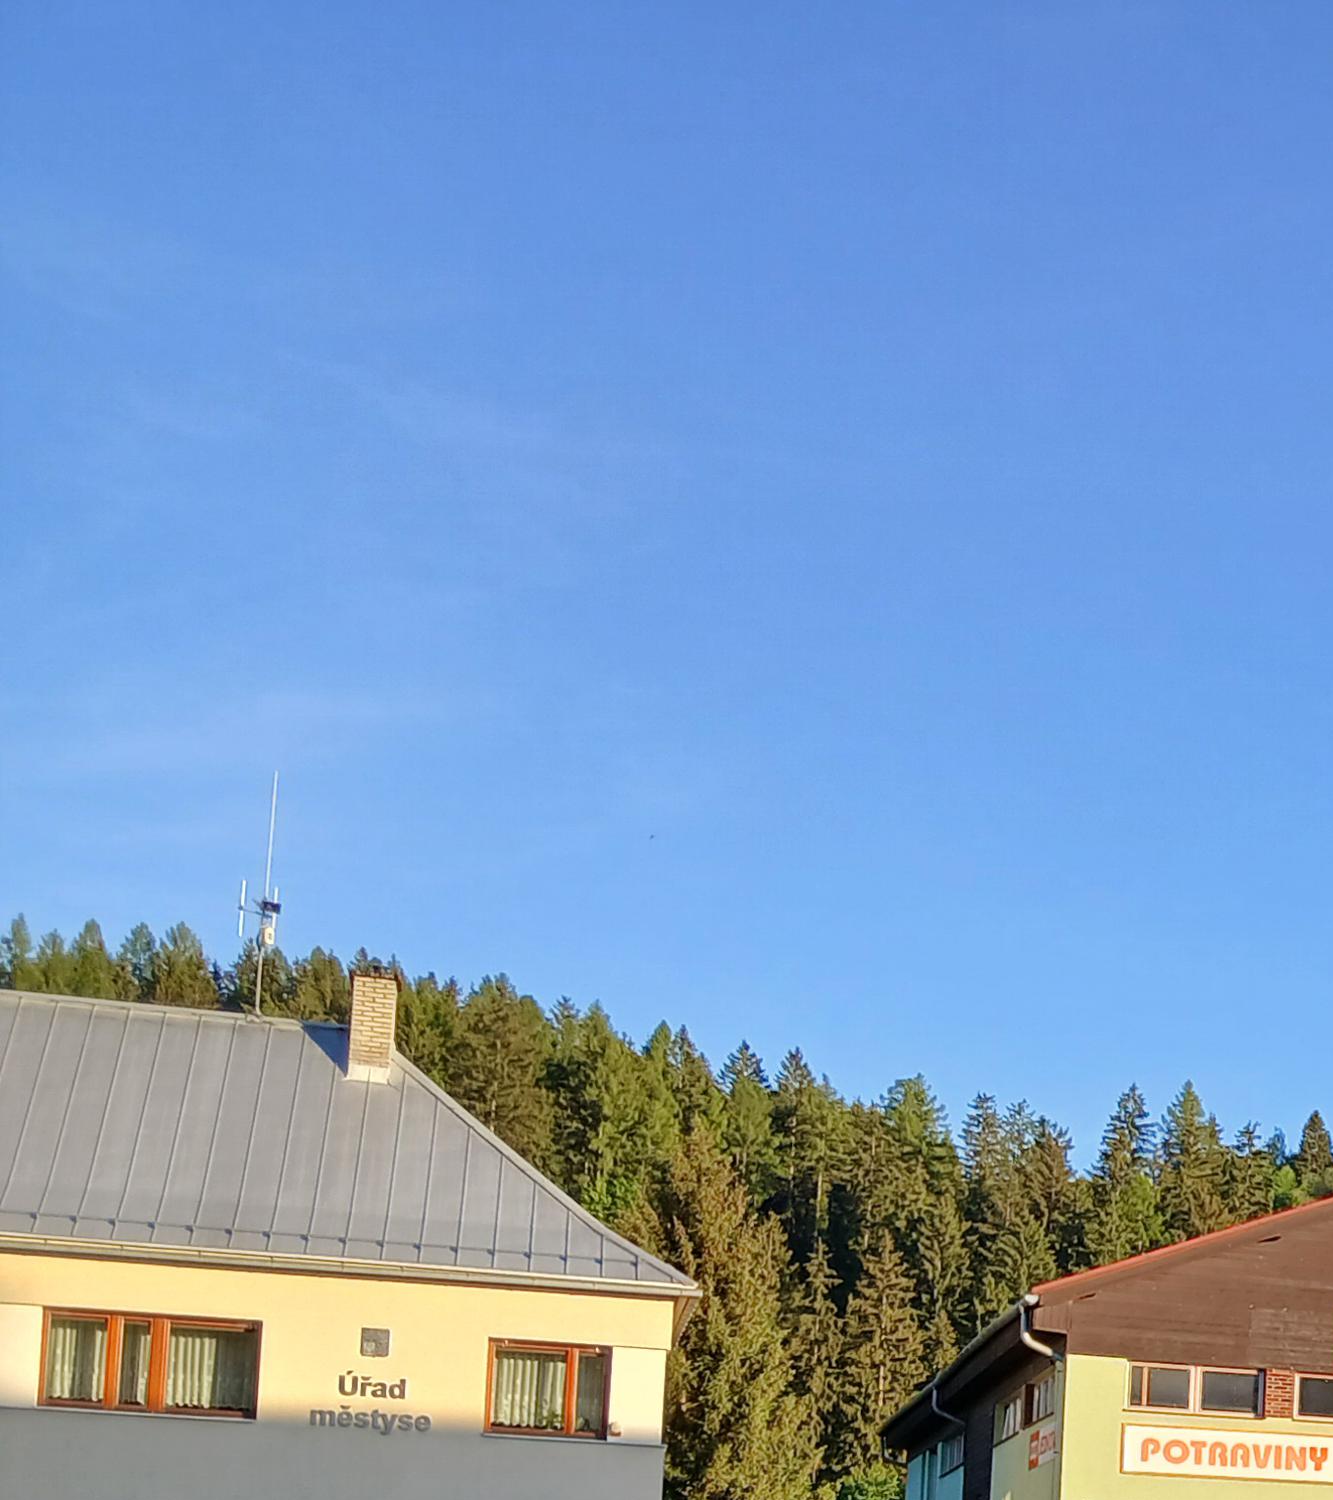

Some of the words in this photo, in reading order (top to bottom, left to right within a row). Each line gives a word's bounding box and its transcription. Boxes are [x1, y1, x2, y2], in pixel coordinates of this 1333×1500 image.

[338, 1370, 406, 1400] Úřad
[309, 1405, 431, 1436] městyse
[1140, 1437, 1328, 1472] POTRAVINY
